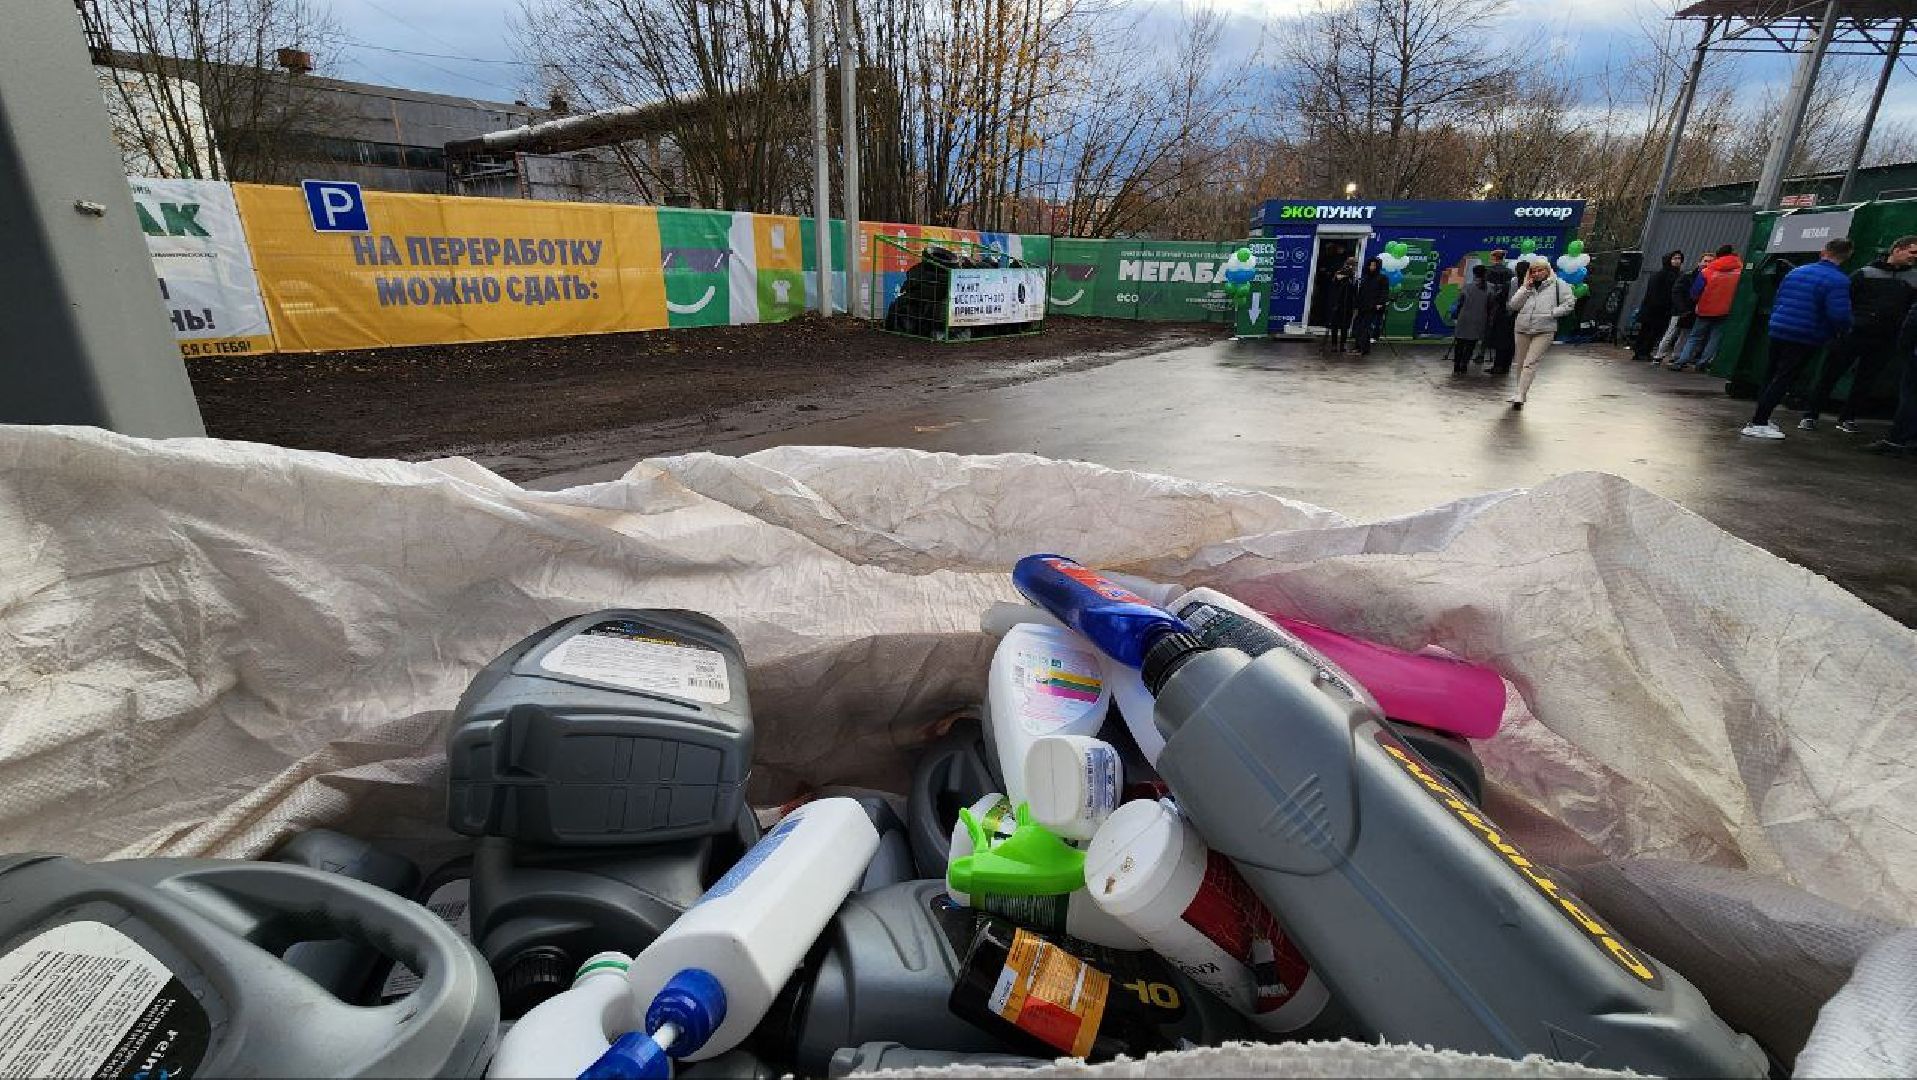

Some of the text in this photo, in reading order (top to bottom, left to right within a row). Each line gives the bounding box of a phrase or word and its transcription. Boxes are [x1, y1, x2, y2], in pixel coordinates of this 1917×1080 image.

[320, 187, 354, 226] P
[1281, 205, 1377, 219] ЭКОПУНКТ
[1515, 207, 1573, 221] ecovap
[351, 235, 602, 266] НА ПЕРЕРАБОТКУ
[375, 275, 600, 306] МОЖНО СДАТЬ:
[1418, 250, 1440, 311] ecovap
[1381, 744, 1654, 979] OPTIMUM
